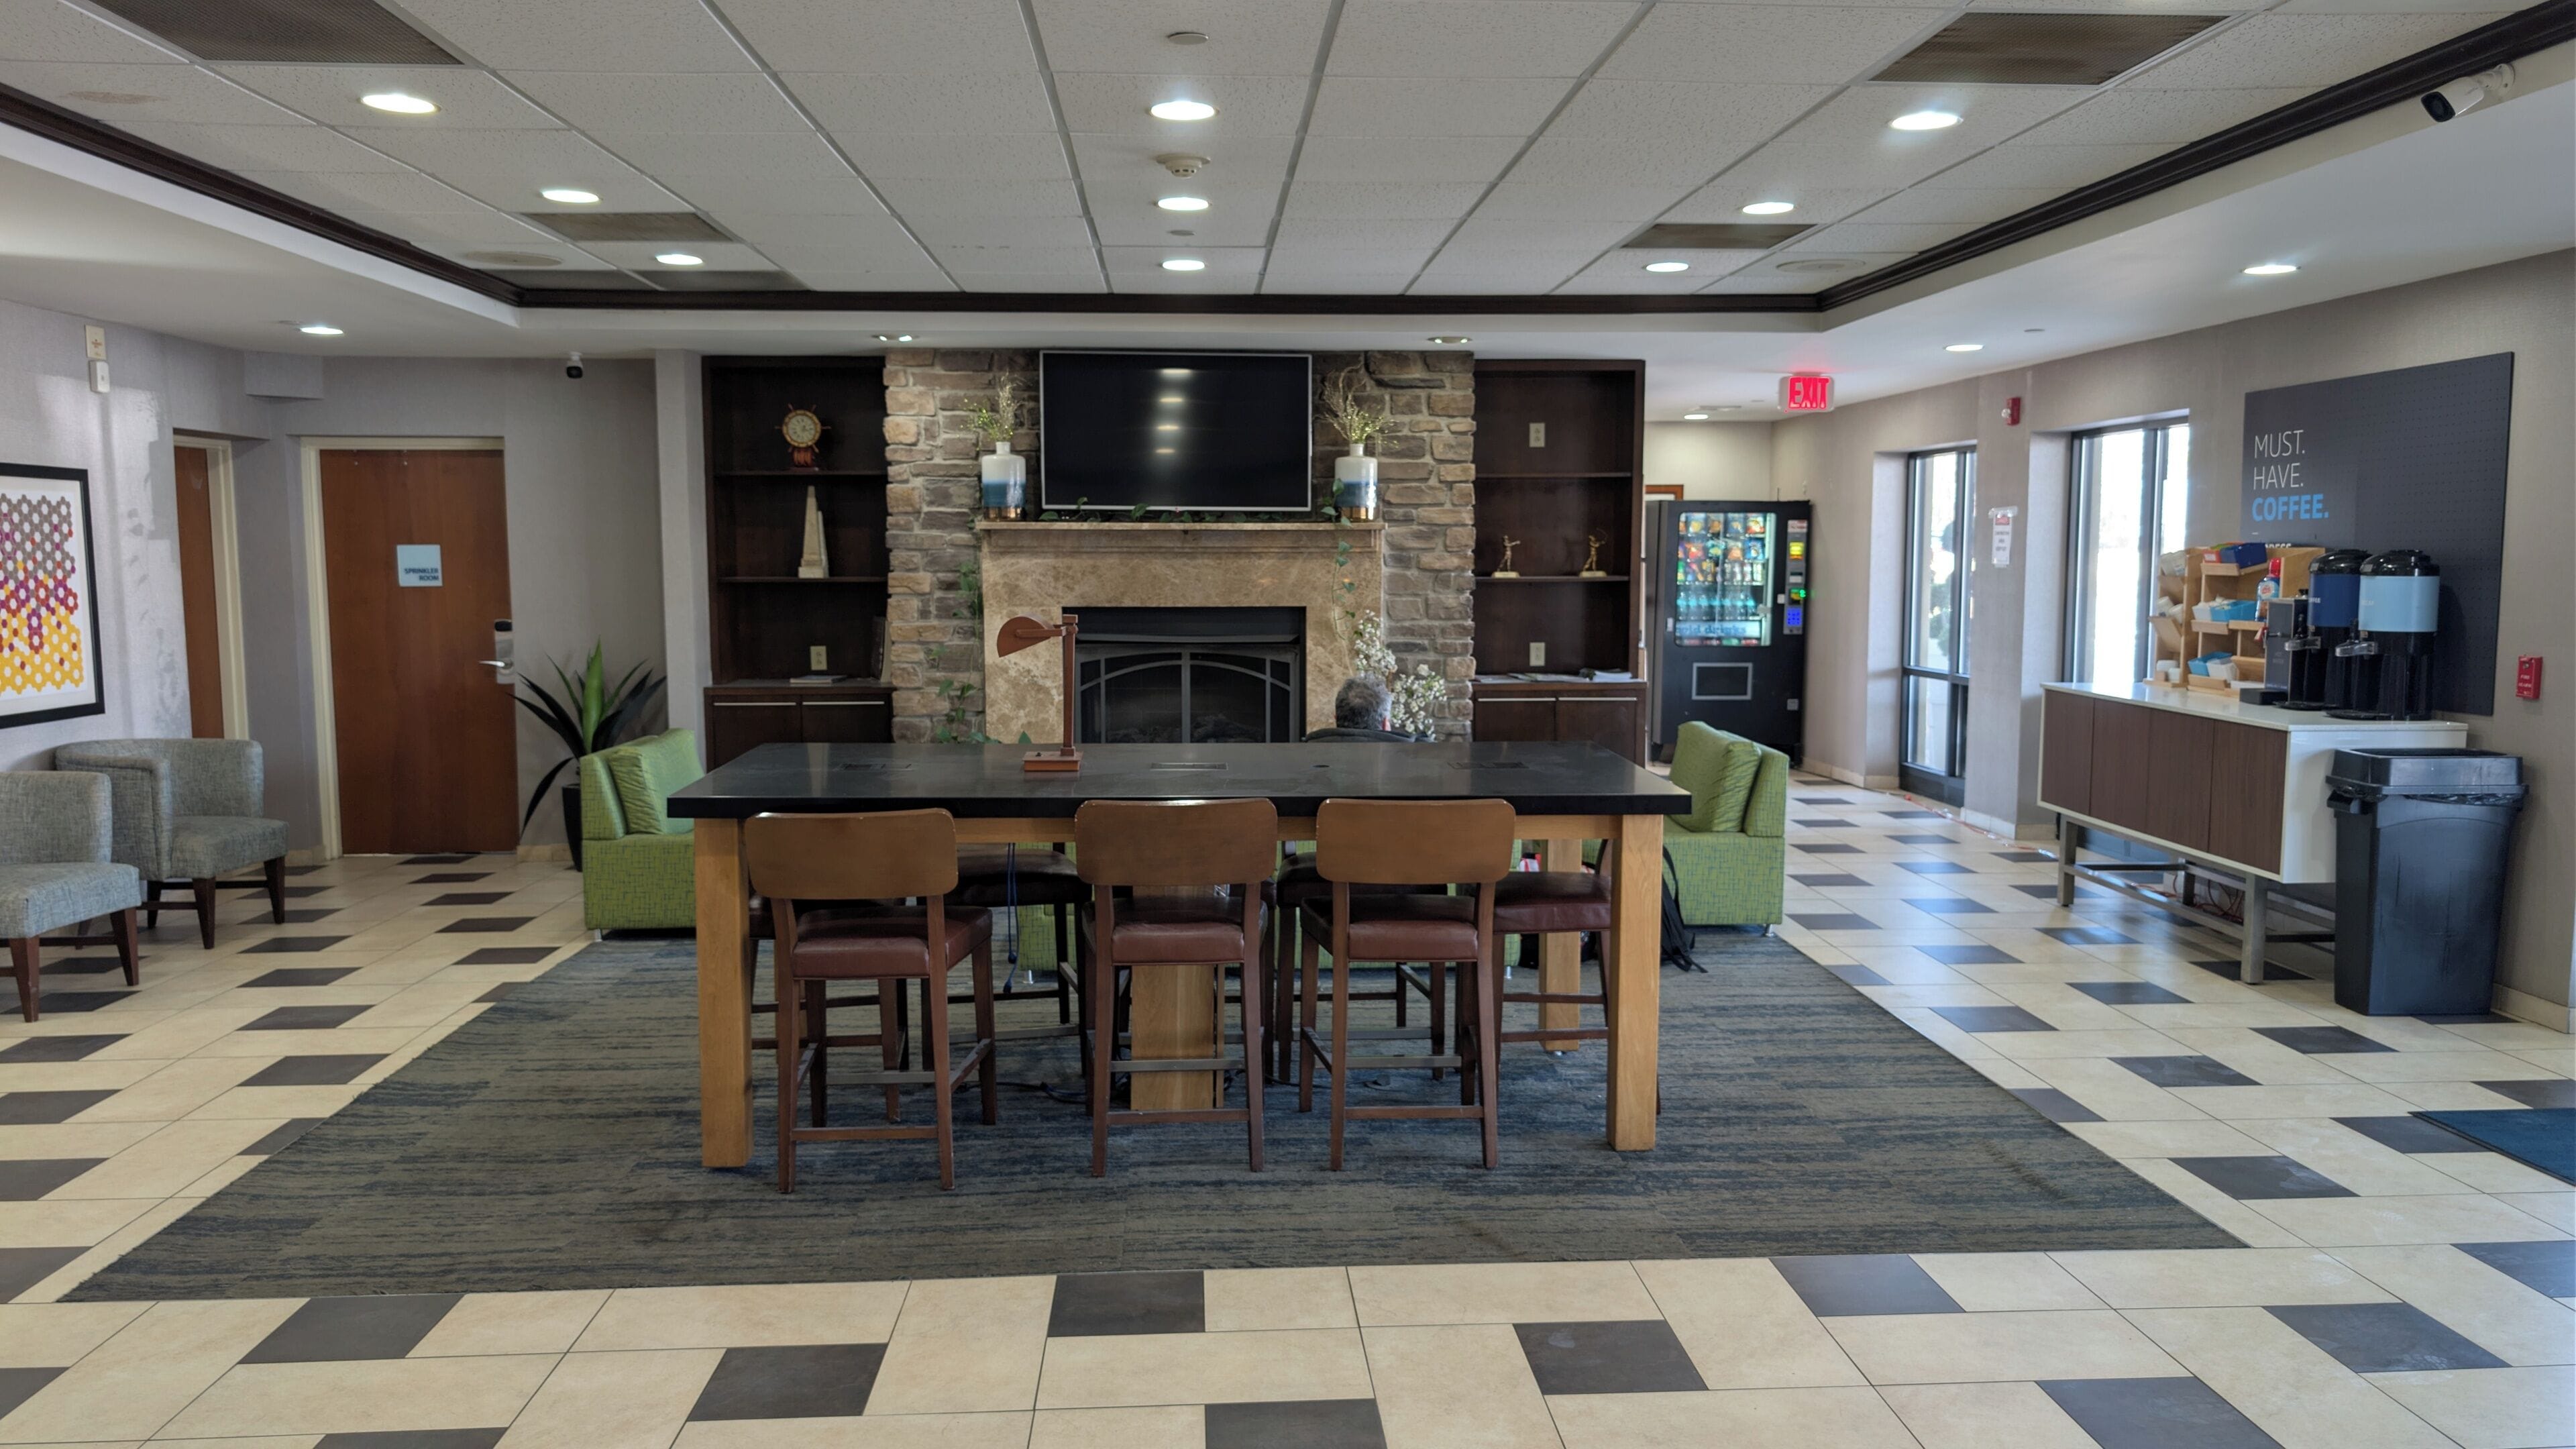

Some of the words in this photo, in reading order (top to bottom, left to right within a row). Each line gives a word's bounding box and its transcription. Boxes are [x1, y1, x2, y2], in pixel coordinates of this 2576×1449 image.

[1788, 377, 1829, 409] EXIT
[2254, 429, 2305, 459] MUST.
[2253, 463, 2304, 490] HAVE.
[2252, 494, 2329, 522] COFFEE.
